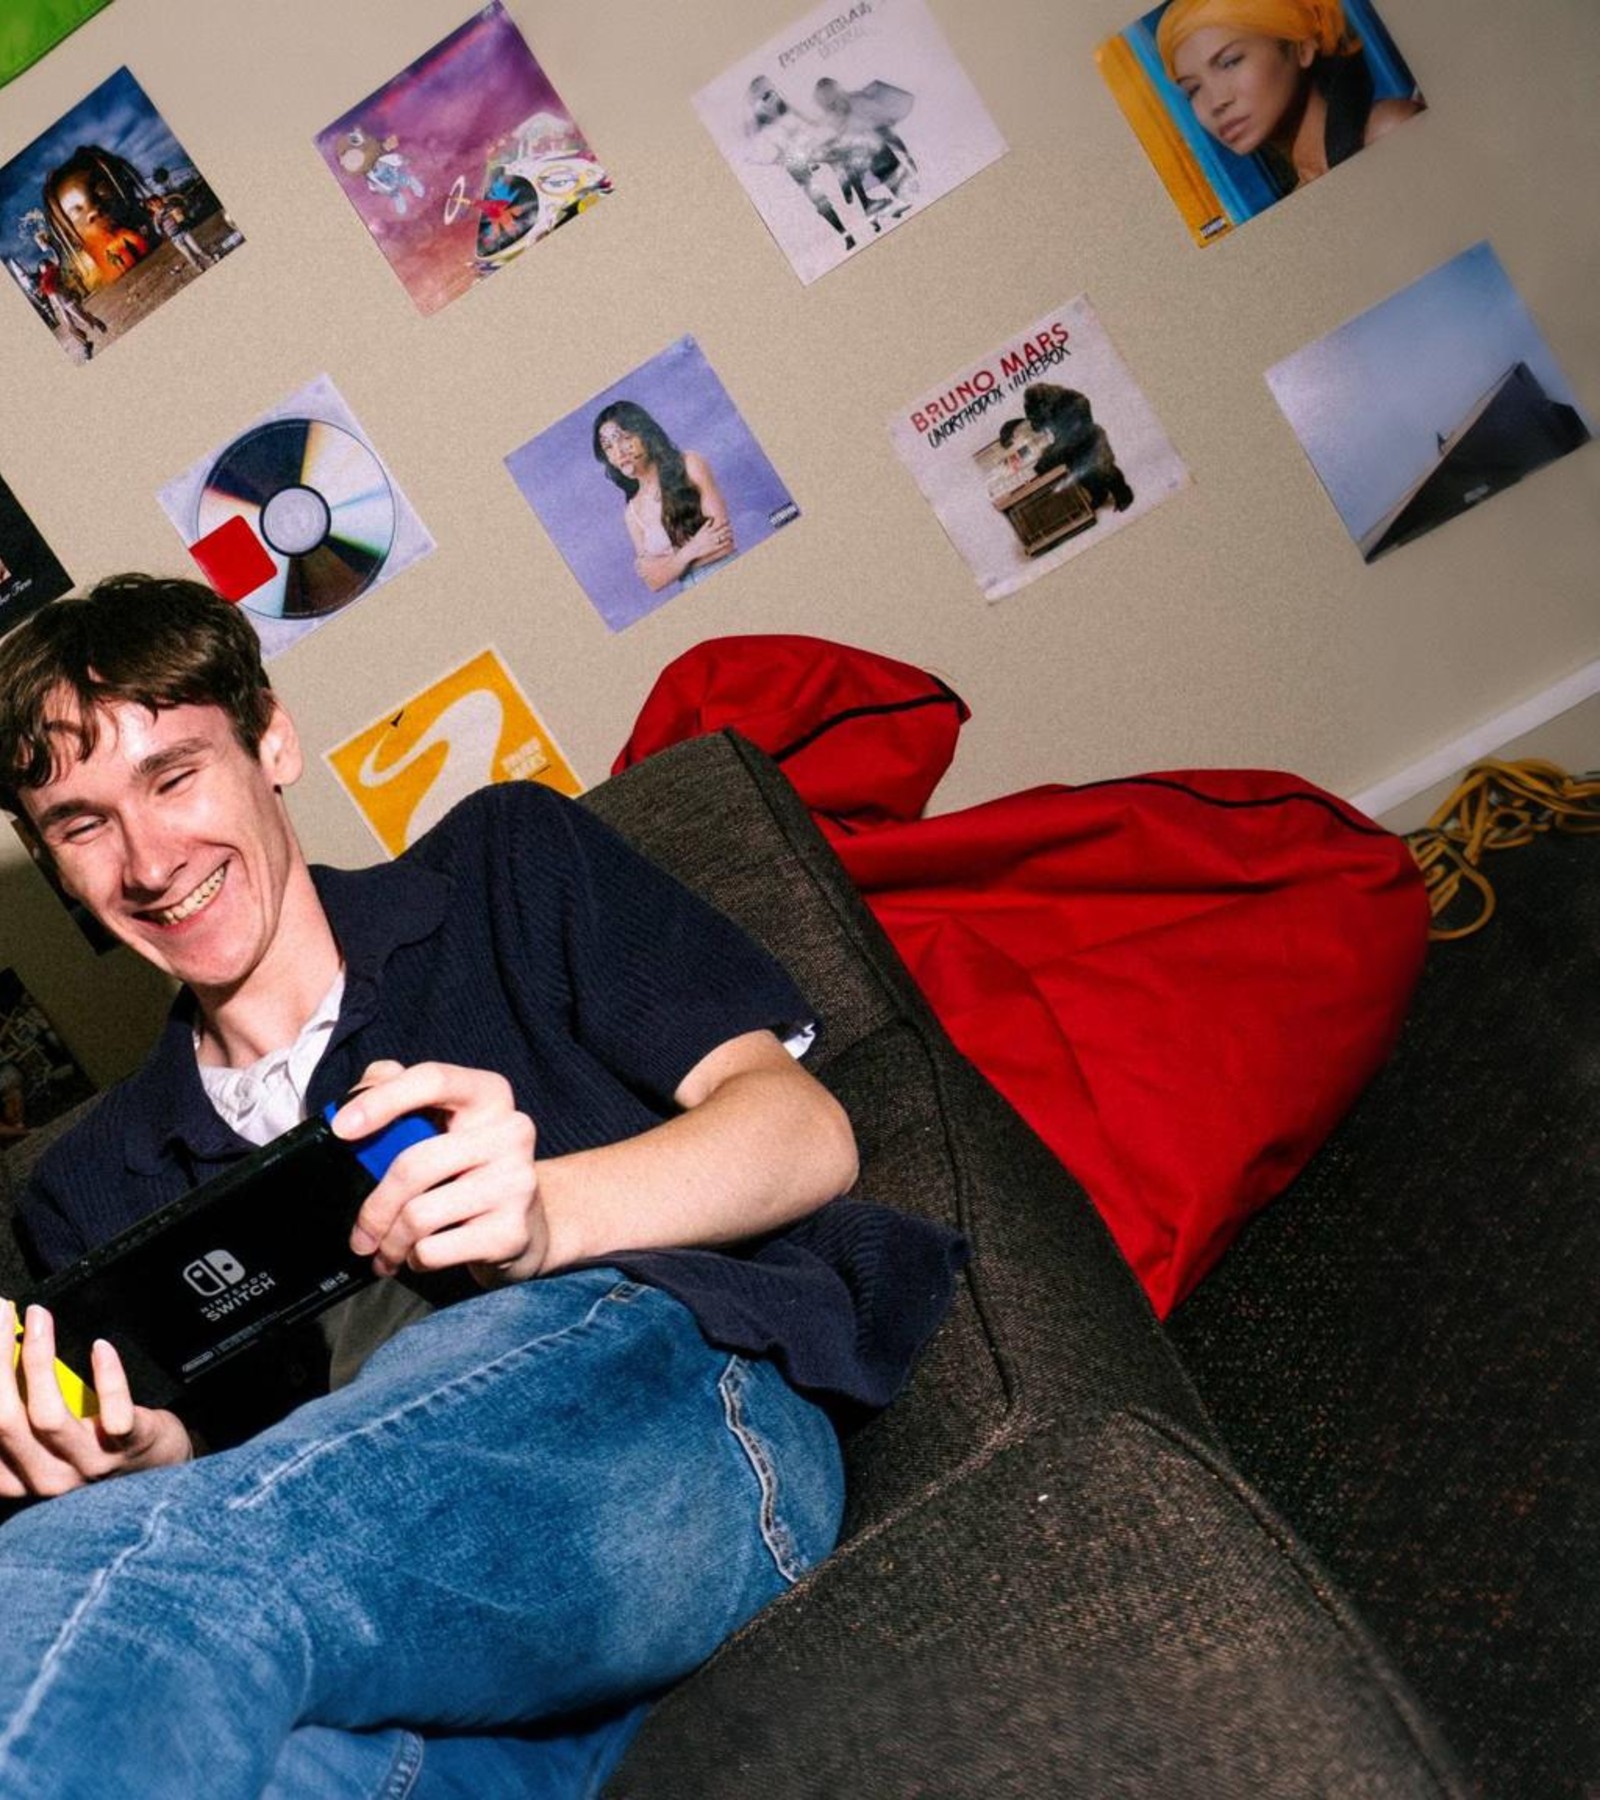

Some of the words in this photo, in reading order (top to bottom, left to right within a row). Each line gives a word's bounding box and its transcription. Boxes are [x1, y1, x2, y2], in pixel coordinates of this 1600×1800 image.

[910, 369, 996, 434] BRUNO
[999, 322, 1070, 378] MARS
[927, 384, 1006, 449] UNORTHODOX
[1007, 340, 1072, 392] JUKEBOX
[200, 1271, 269, 1314] NINTENDO
[205, 1276, 277, 1323] SWITCH
